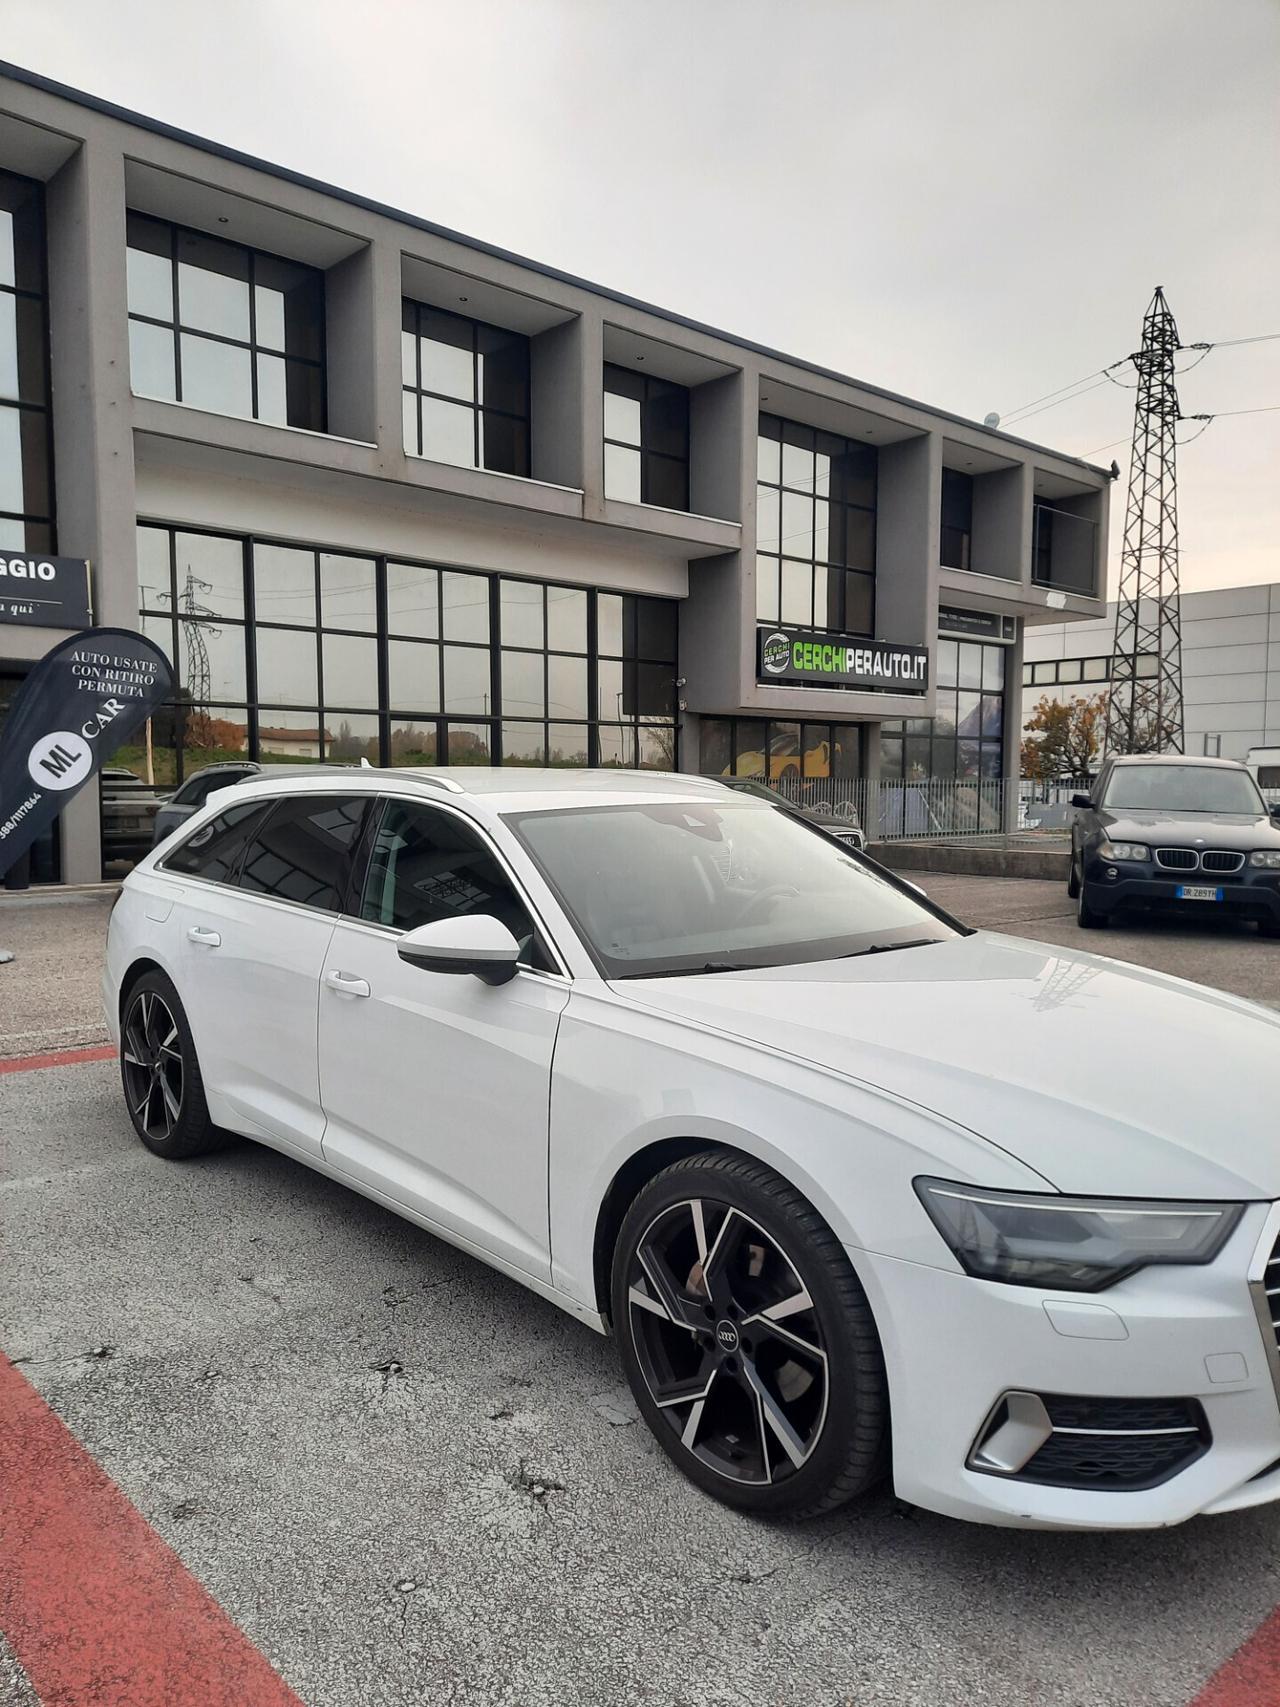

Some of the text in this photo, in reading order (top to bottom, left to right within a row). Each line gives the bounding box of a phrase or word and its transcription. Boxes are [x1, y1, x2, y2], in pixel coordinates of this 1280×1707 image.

[764, 642, 790, 657] CERCHI
[764, 650, 790, 665] PER AUTO
[71, 651, 158, 673] AUTO USATE
[793, 641, 927, 680] CERCHIPERAUTO.IT
[72, 665, 154, 685] CON RITIRO
[78, 679, 144, 698] PERMUTA
[39, 698, 126, 779] ML CAR
